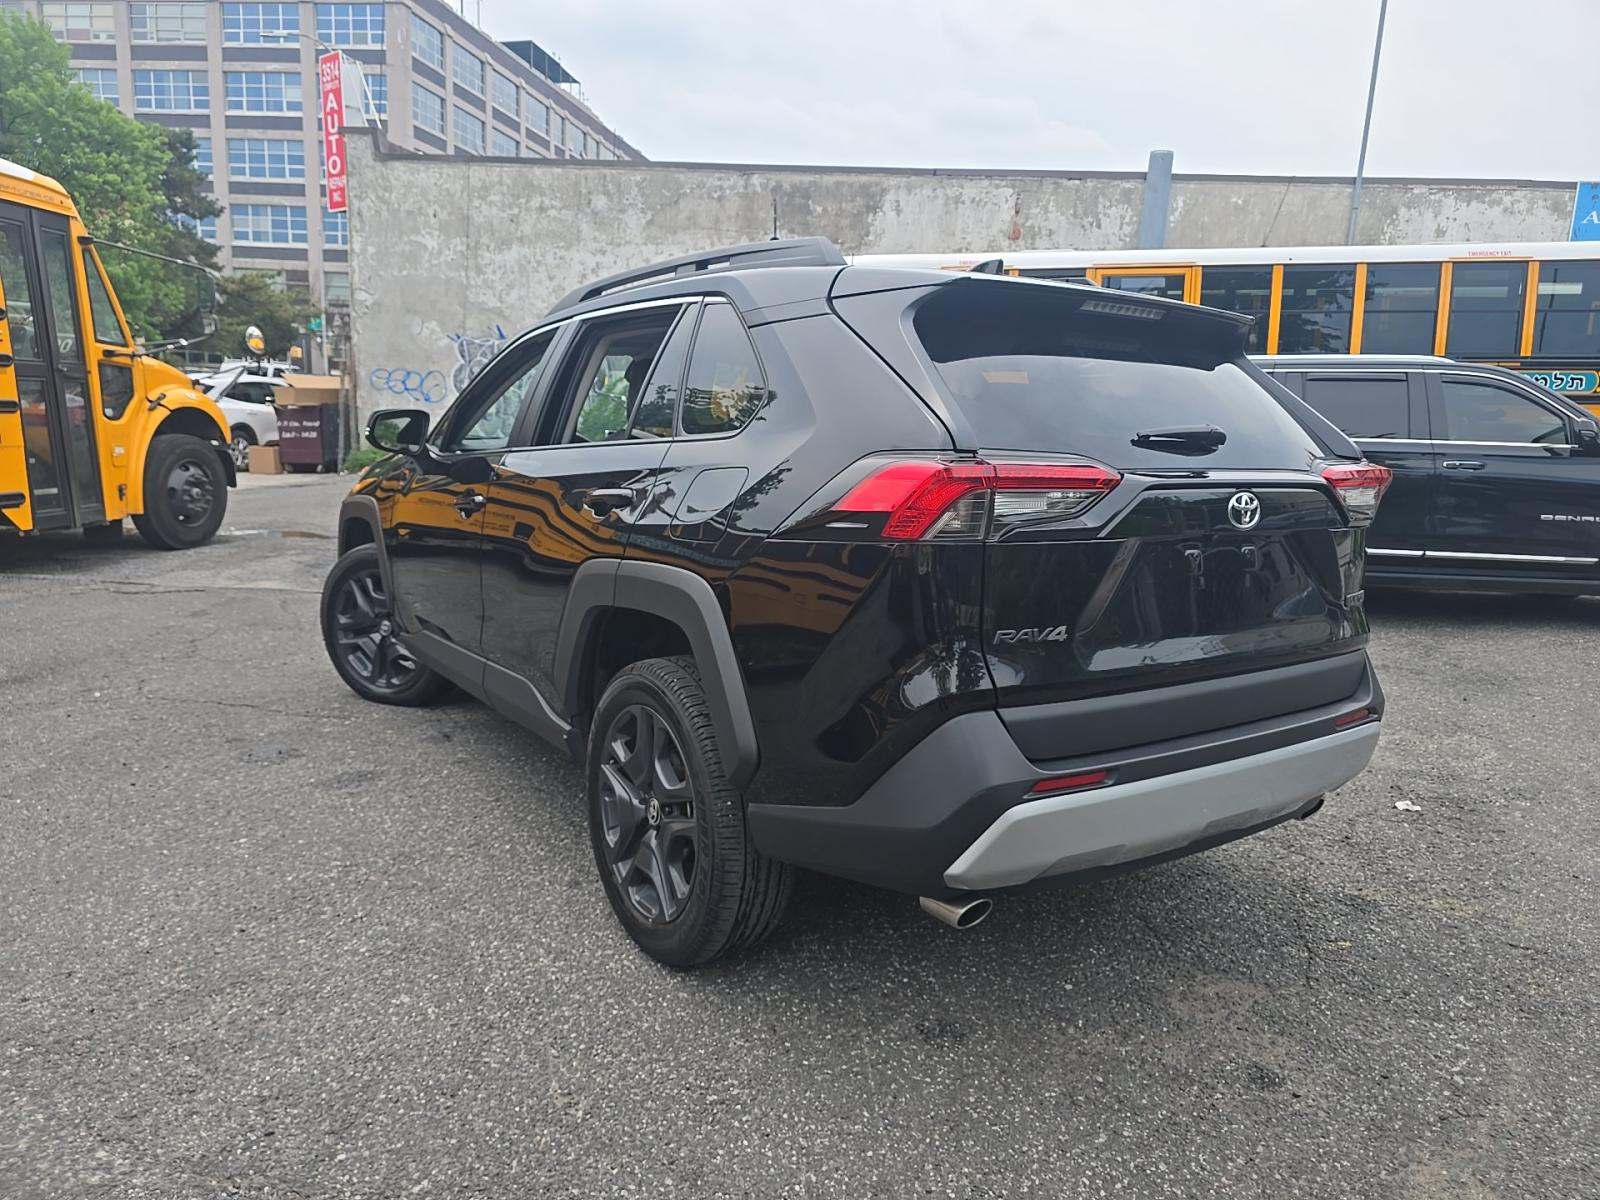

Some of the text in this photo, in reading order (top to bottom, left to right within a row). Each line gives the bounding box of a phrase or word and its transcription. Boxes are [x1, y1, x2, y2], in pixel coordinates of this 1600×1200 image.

[322, 60, 339, 82] 3514
[326, 92, 342, 175] AUTO
[992, 625, 1068, 645] RAV4
